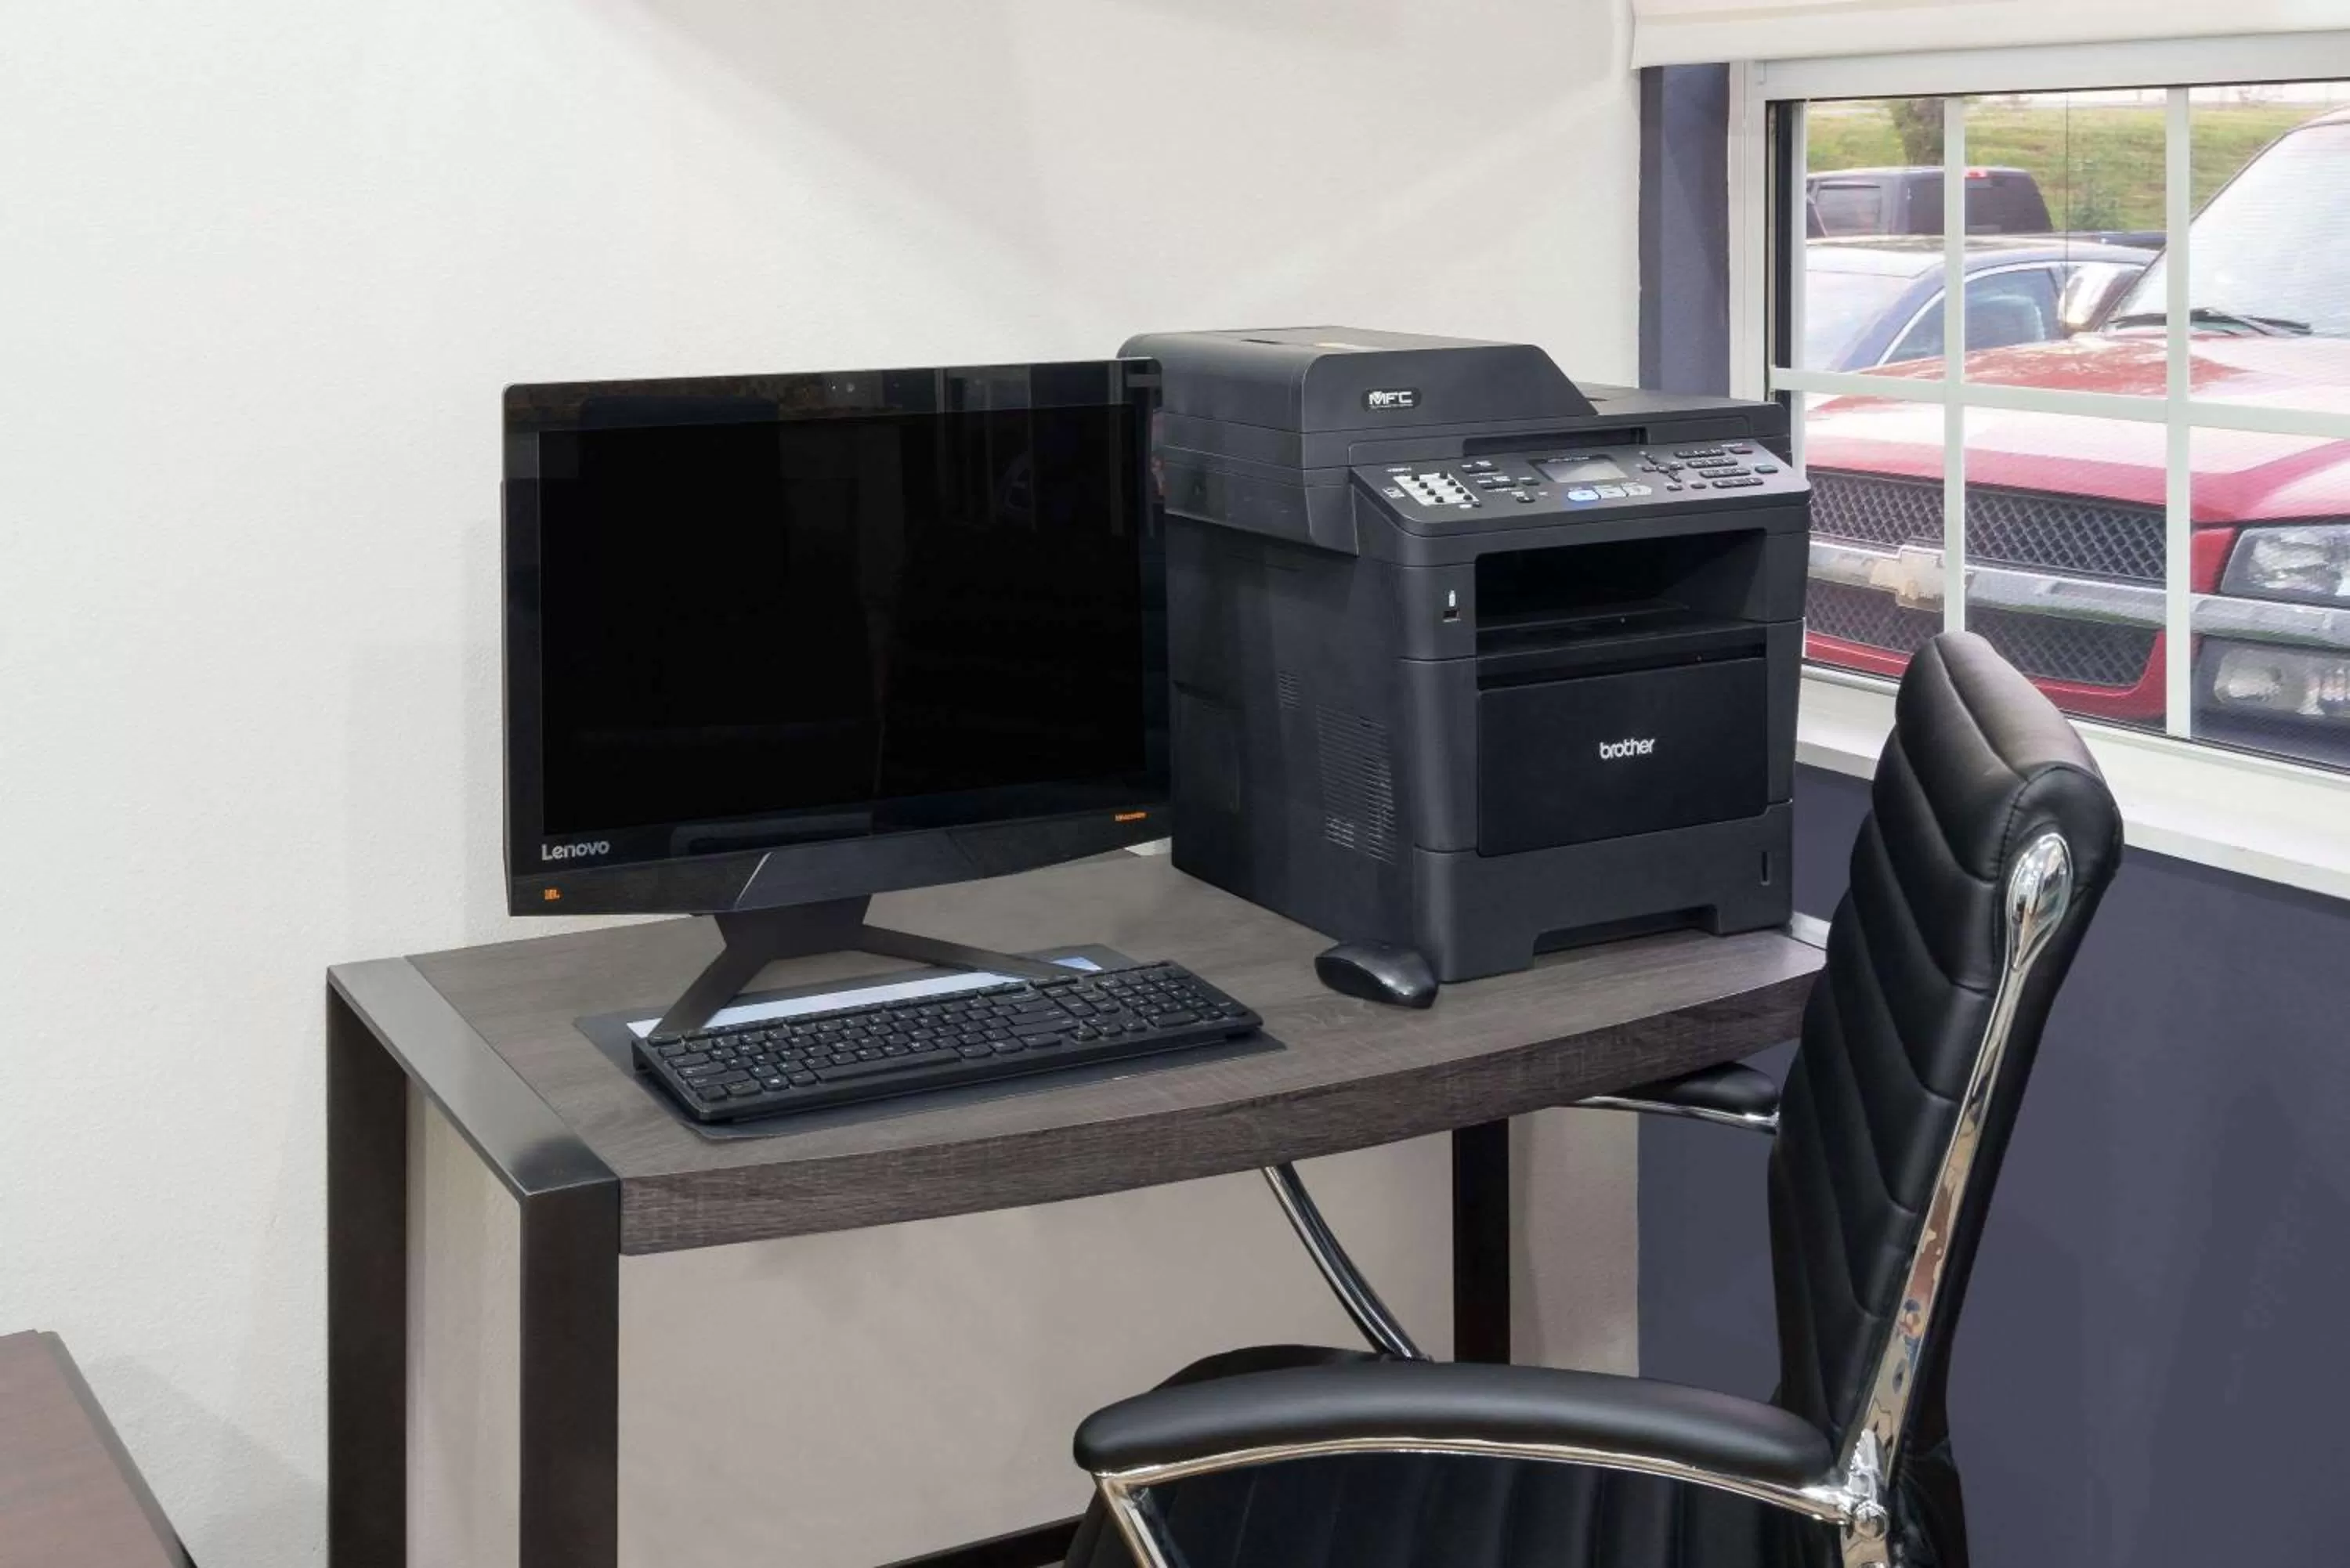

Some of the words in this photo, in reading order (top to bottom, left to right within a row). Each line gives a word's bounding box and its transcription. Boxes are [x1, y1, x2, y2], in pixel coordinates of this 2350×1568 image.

[1368, 391, 1412, 405] MFC
[1600, 738, 1655, 760] brother
[541, 840, 610, 861] Lenovo
